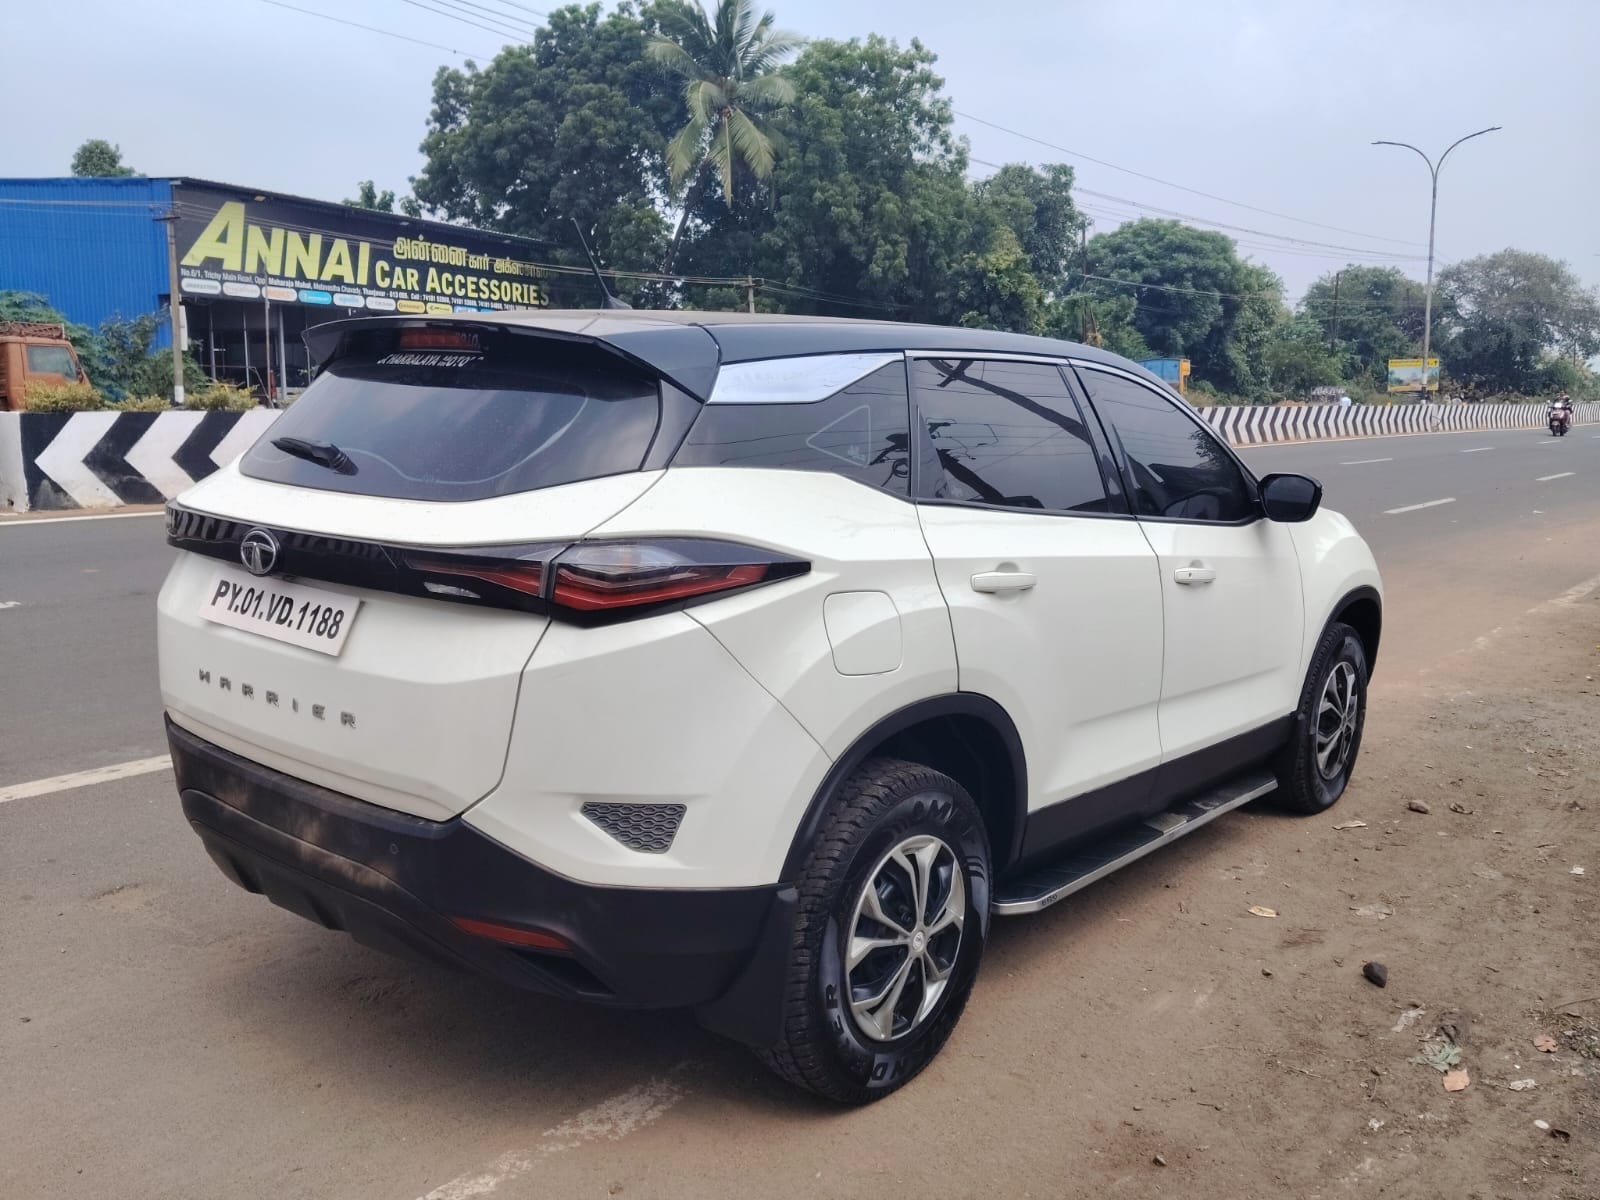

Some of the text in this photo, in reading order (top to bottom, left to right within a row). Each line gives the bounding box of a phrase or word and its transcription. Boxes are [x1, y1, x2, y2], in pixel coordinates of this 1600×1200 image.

[181, 201, 371, 286] ANNAI
[393, 234, 467, 267] அன்னை
[204, 271, 221, 280] Trichy
[222, 273, 236, 281] Main
[376, 261, 549, 306] CAR ACCESSORIES
[210, 580, 345, 640] PY.01.VD.1188
[199, 668, 356, 729] HARRIER
